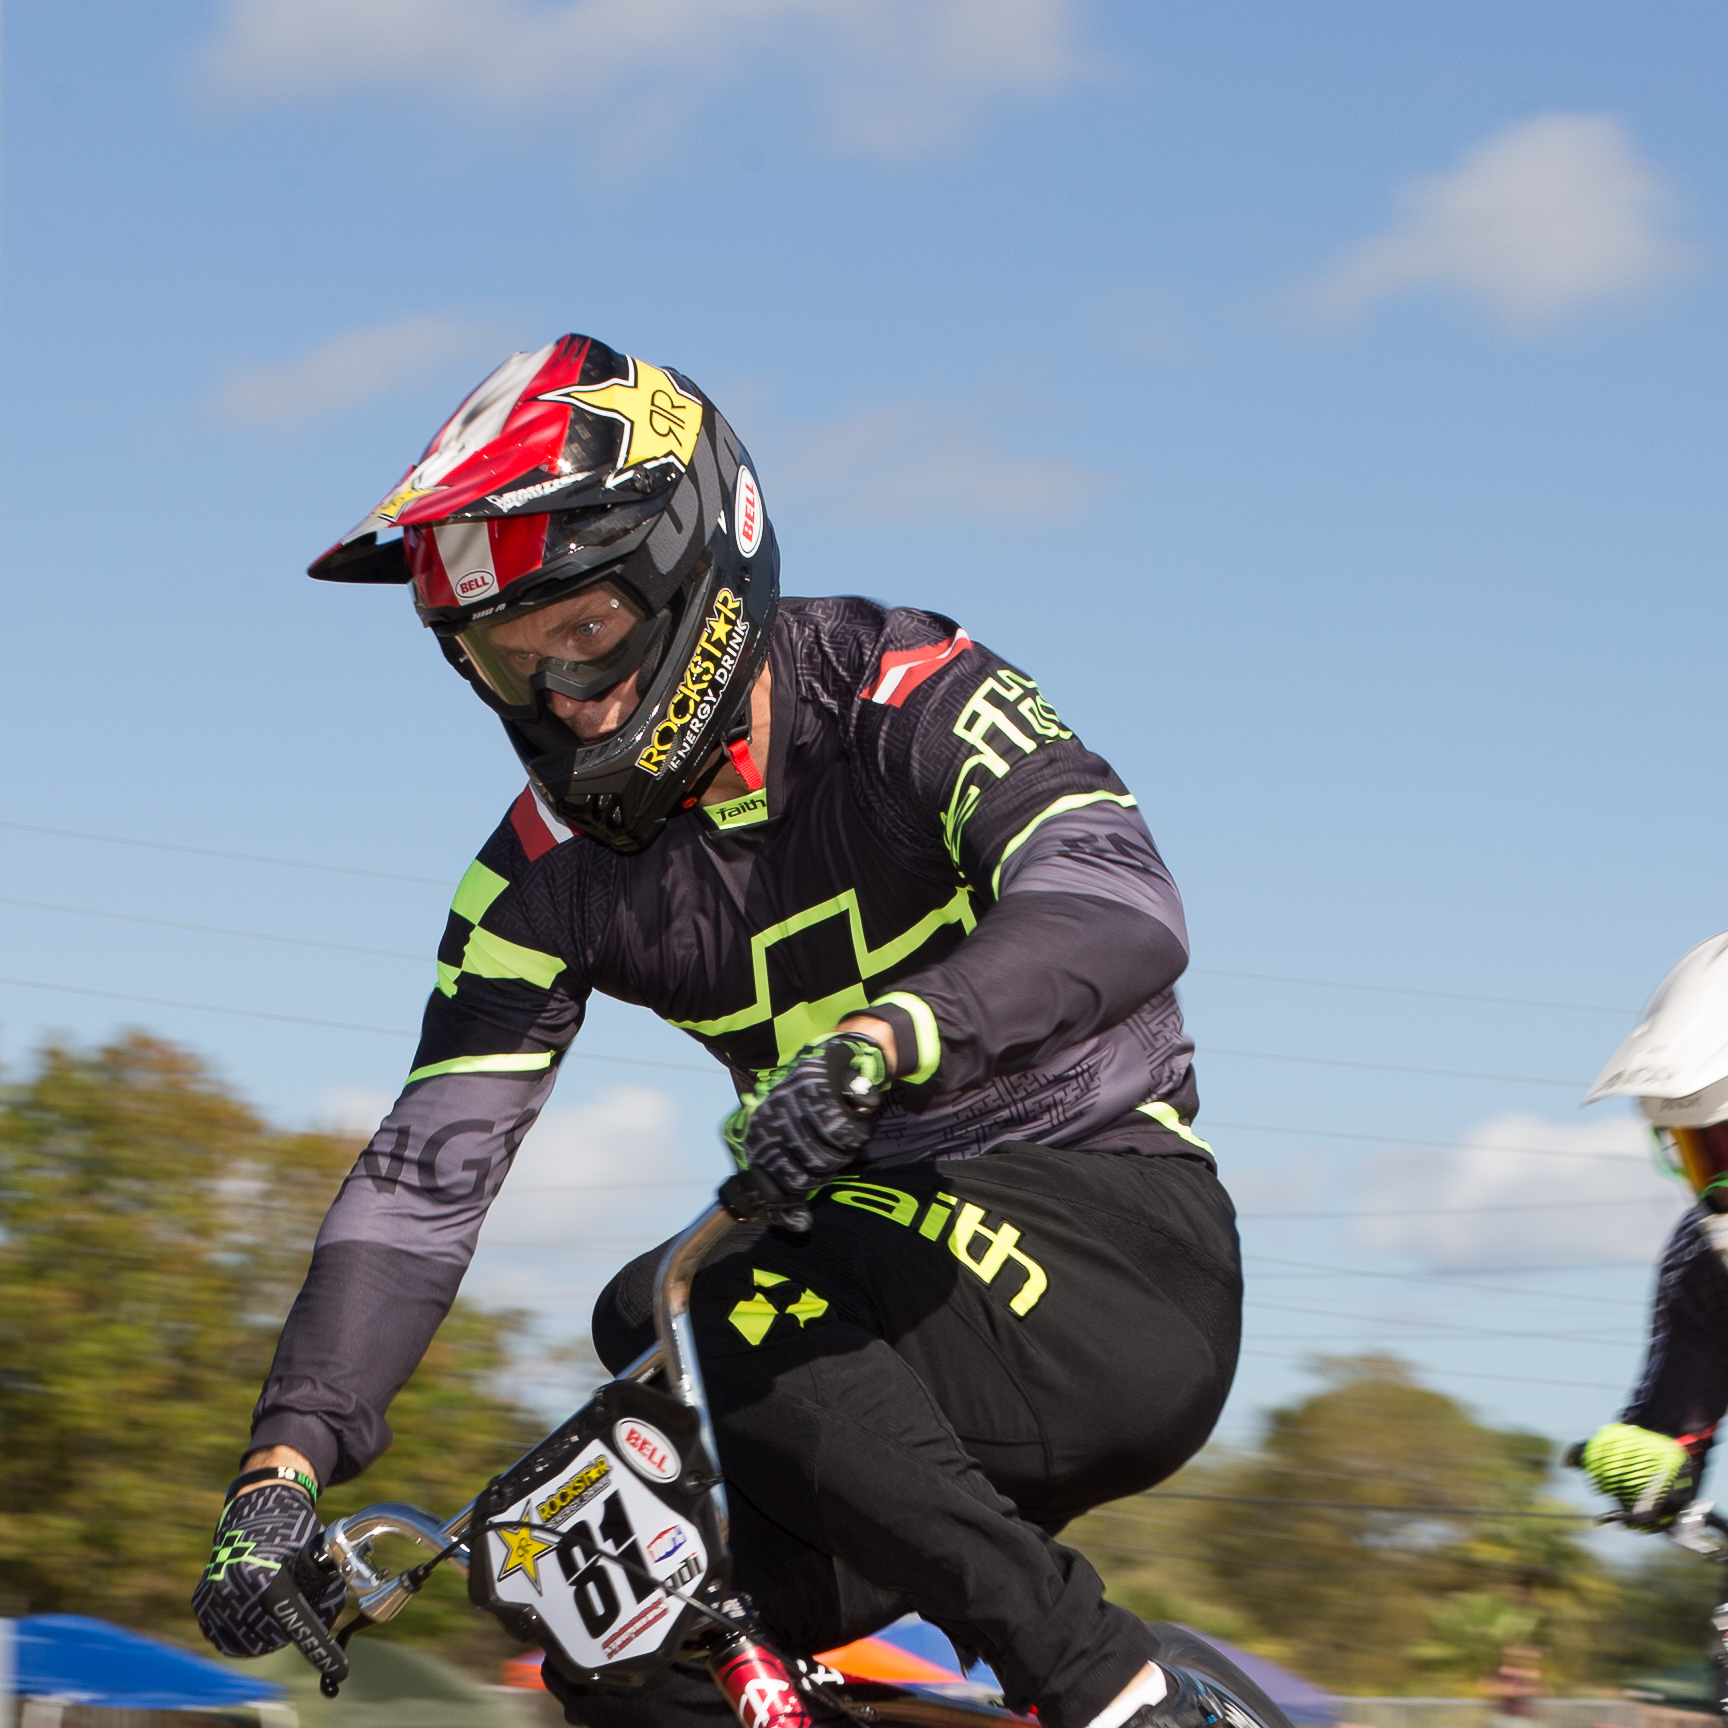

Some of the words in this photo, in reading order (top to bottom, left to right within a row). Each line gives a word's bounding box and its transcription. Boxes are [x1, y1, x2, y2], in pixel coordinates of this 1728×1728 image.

[742, 482, 756, 543] BELL
[459, 575, 490, 595] BELL
[670, 688, 718, 772] ENERGY
[714, 618, 748, 685] DRINK
[715, 798, 767, 823] faith
[807, 1176, 1049, 1318] aith
[625, 1427, 668, 1474] BELL
[555, 1488, 667, 1639] 81
[273, 1598, 339, 1673] UNSEEN
